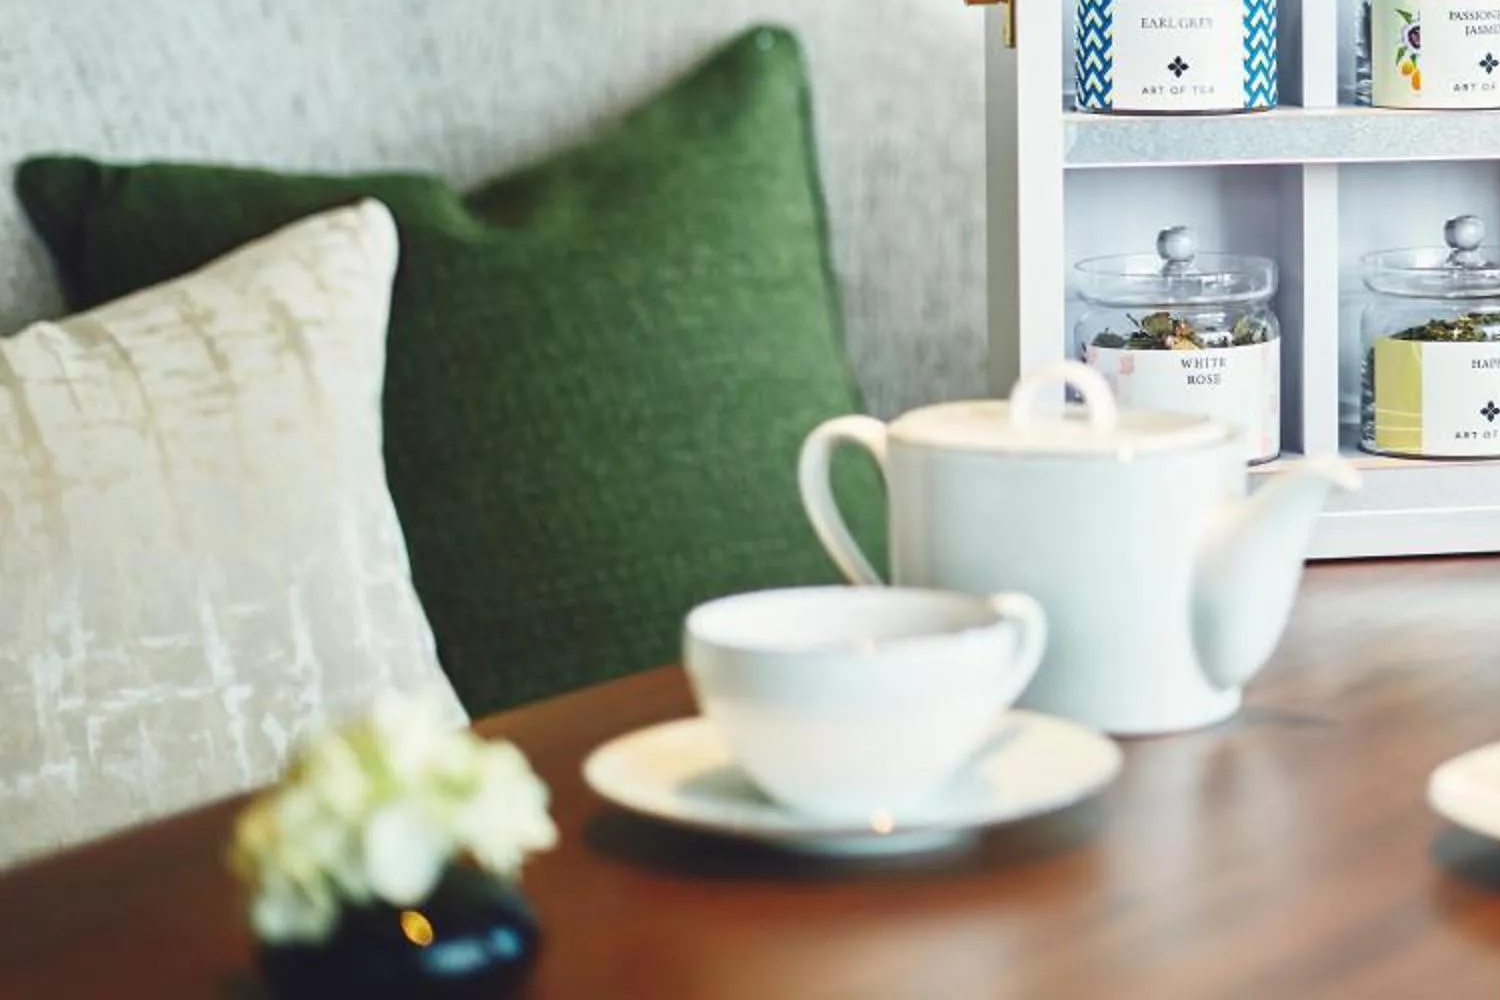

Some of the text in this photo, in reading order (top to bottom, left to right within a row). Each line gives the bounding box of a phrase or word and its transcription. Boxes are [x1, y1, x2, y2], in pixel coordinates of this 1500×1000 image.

[1141, 17, 1214, 29] EARL GREY
[1141, 86, 1214, 95] ART OF TEA
[1453, 84, 1476, 92] ART
[1482, 83, 1496, 91] OF
[1181, 357, 1227, 369] WHITE
[1187, 373, 1222, 385] ROSE
[1455, 430, 1477, 439] ART
[1484, 429, 1498, 438] OF
